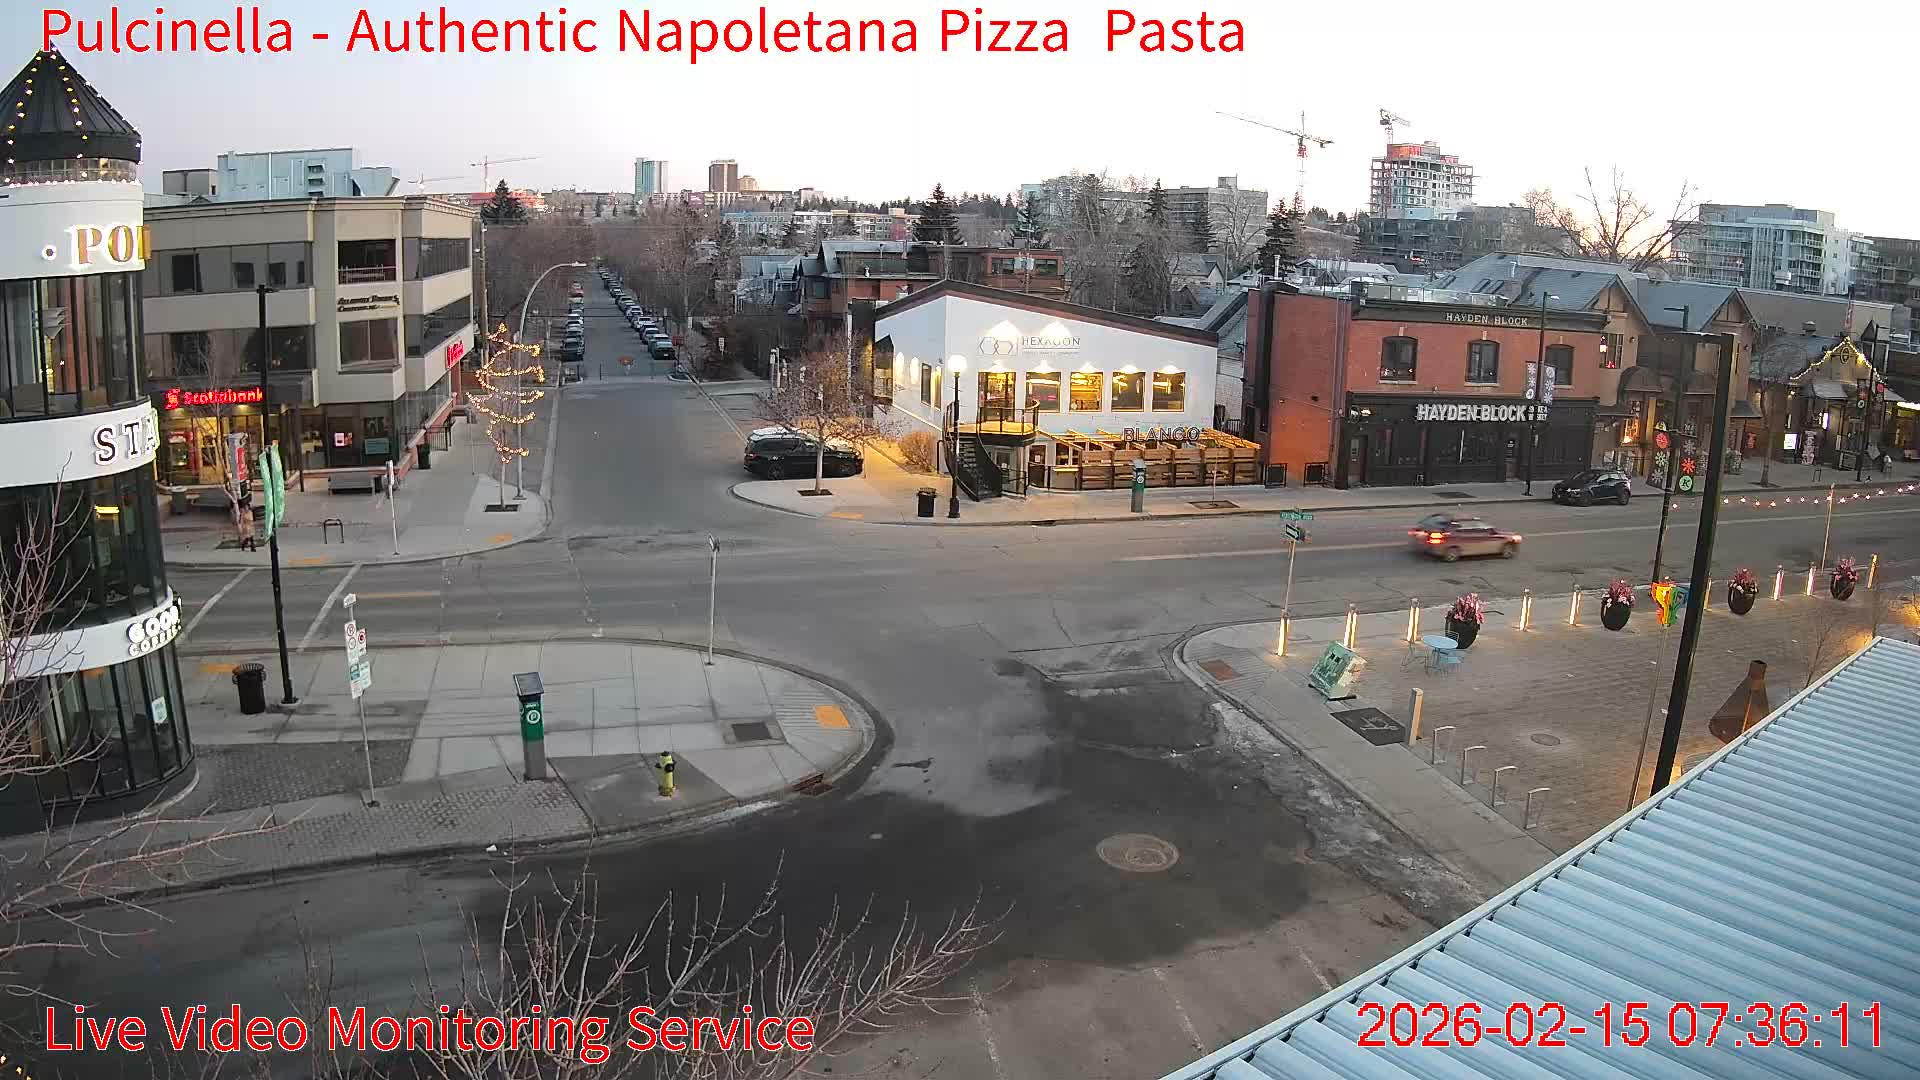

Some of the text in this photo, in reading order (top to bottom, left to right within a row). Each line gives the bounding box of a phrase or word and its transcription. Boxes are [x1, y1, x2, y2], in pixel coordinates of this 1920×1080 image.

[1446, 313, 1528, 326] HAYDEN BLOCK
[1022, 336, 1080, 346] HEXAGON
[183, 387, 263, 405] Scotiabank
[1416, 403, 1527, 422] HAYDEN BLOCK
[1123, 426, 1201, 441] BLANCO
